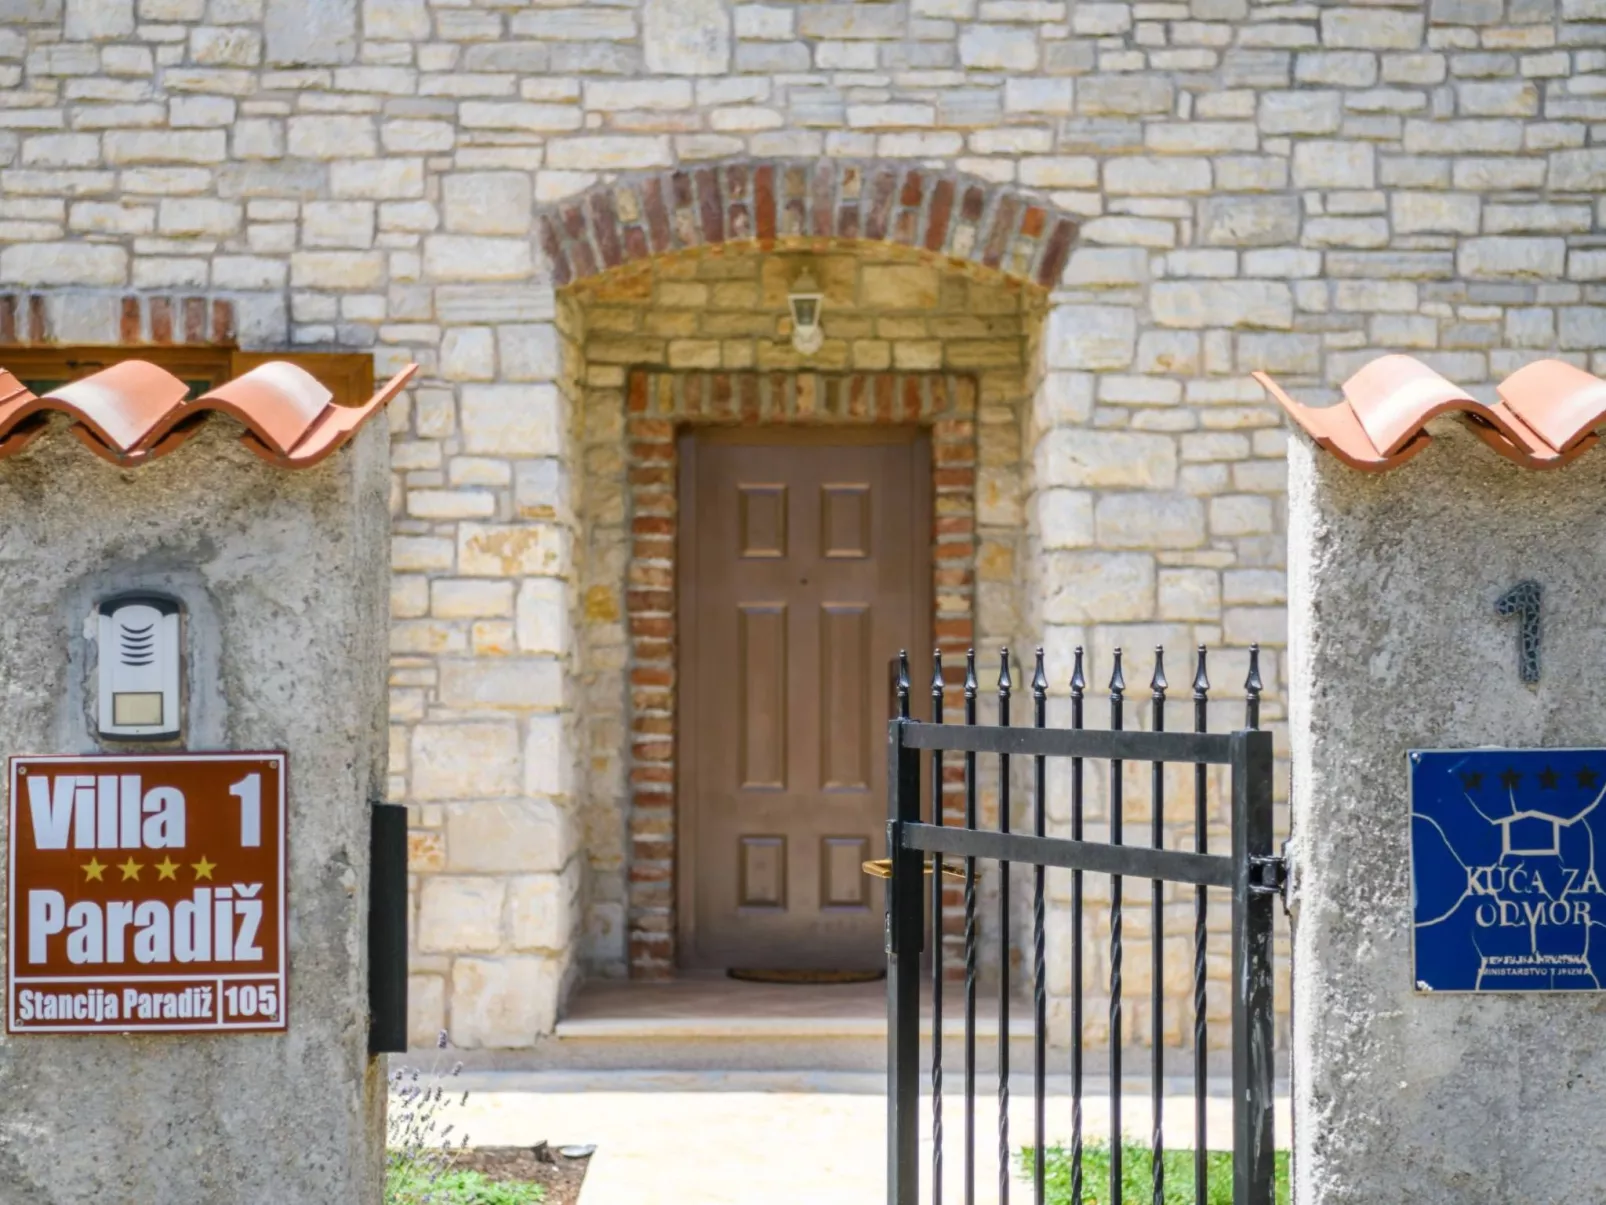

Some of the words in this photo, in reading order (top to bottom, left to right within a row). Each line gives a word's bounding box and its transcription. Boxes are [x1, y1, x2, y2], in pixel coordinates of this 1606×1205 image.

[1494, 578, 1544, 683] 1
[26, 774, 187, 850] Villa
[229, 773, 261, 848] 1
[1466, 863, 1545, 896] KUĆA
[1562, 868, 1603, 895] ZA
[28, 882, 264, 965] Paradiž
[1475, 900, 1593, 928] ODMOR
[19, 988, 119, 1022] Stancija
[123, 986, 213, 1020] Paradiž
[224, 985, 277, 1017] 105
